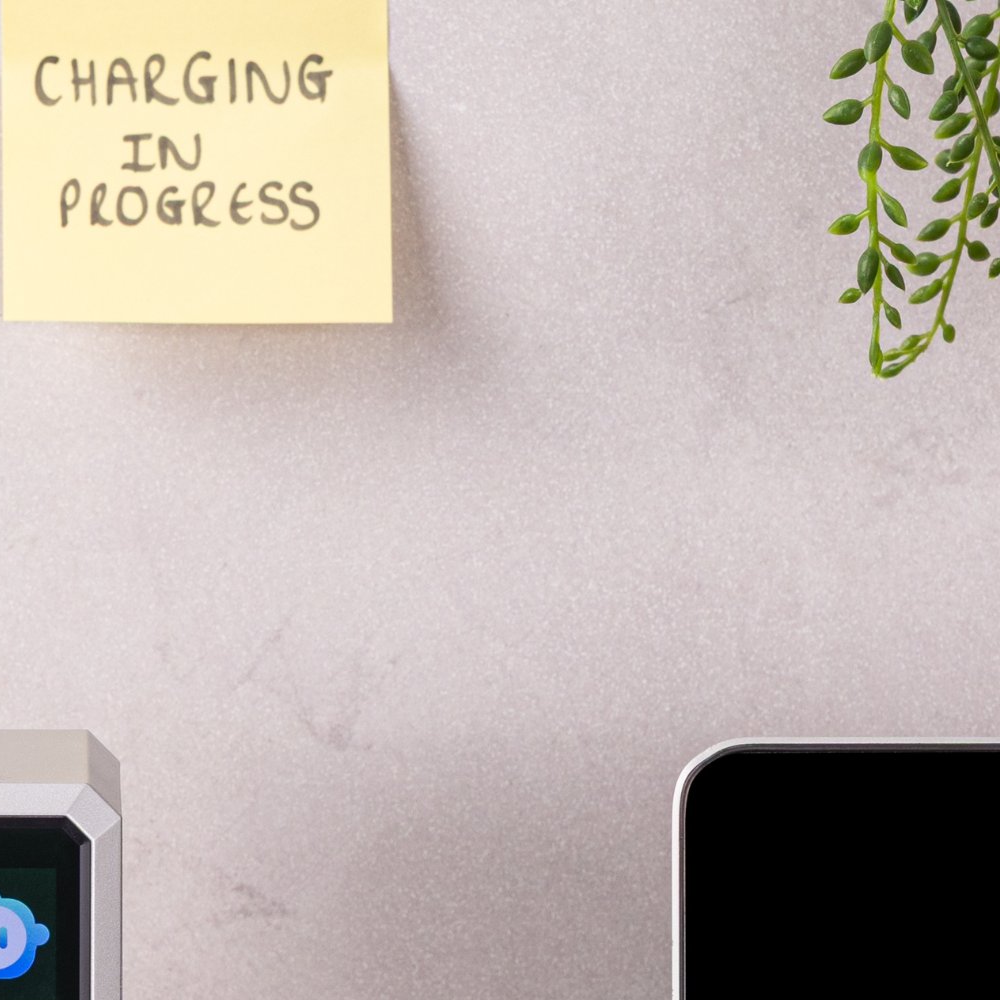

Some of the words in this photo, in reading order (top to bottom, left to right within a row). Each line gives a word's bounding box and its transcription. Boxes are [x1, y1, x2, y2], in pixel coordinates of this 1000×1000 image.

[36, 52, 333, 106] CHARGING
[121, 133, 201, 172] IN
[60, 178, 320, 231] PROGRESS
